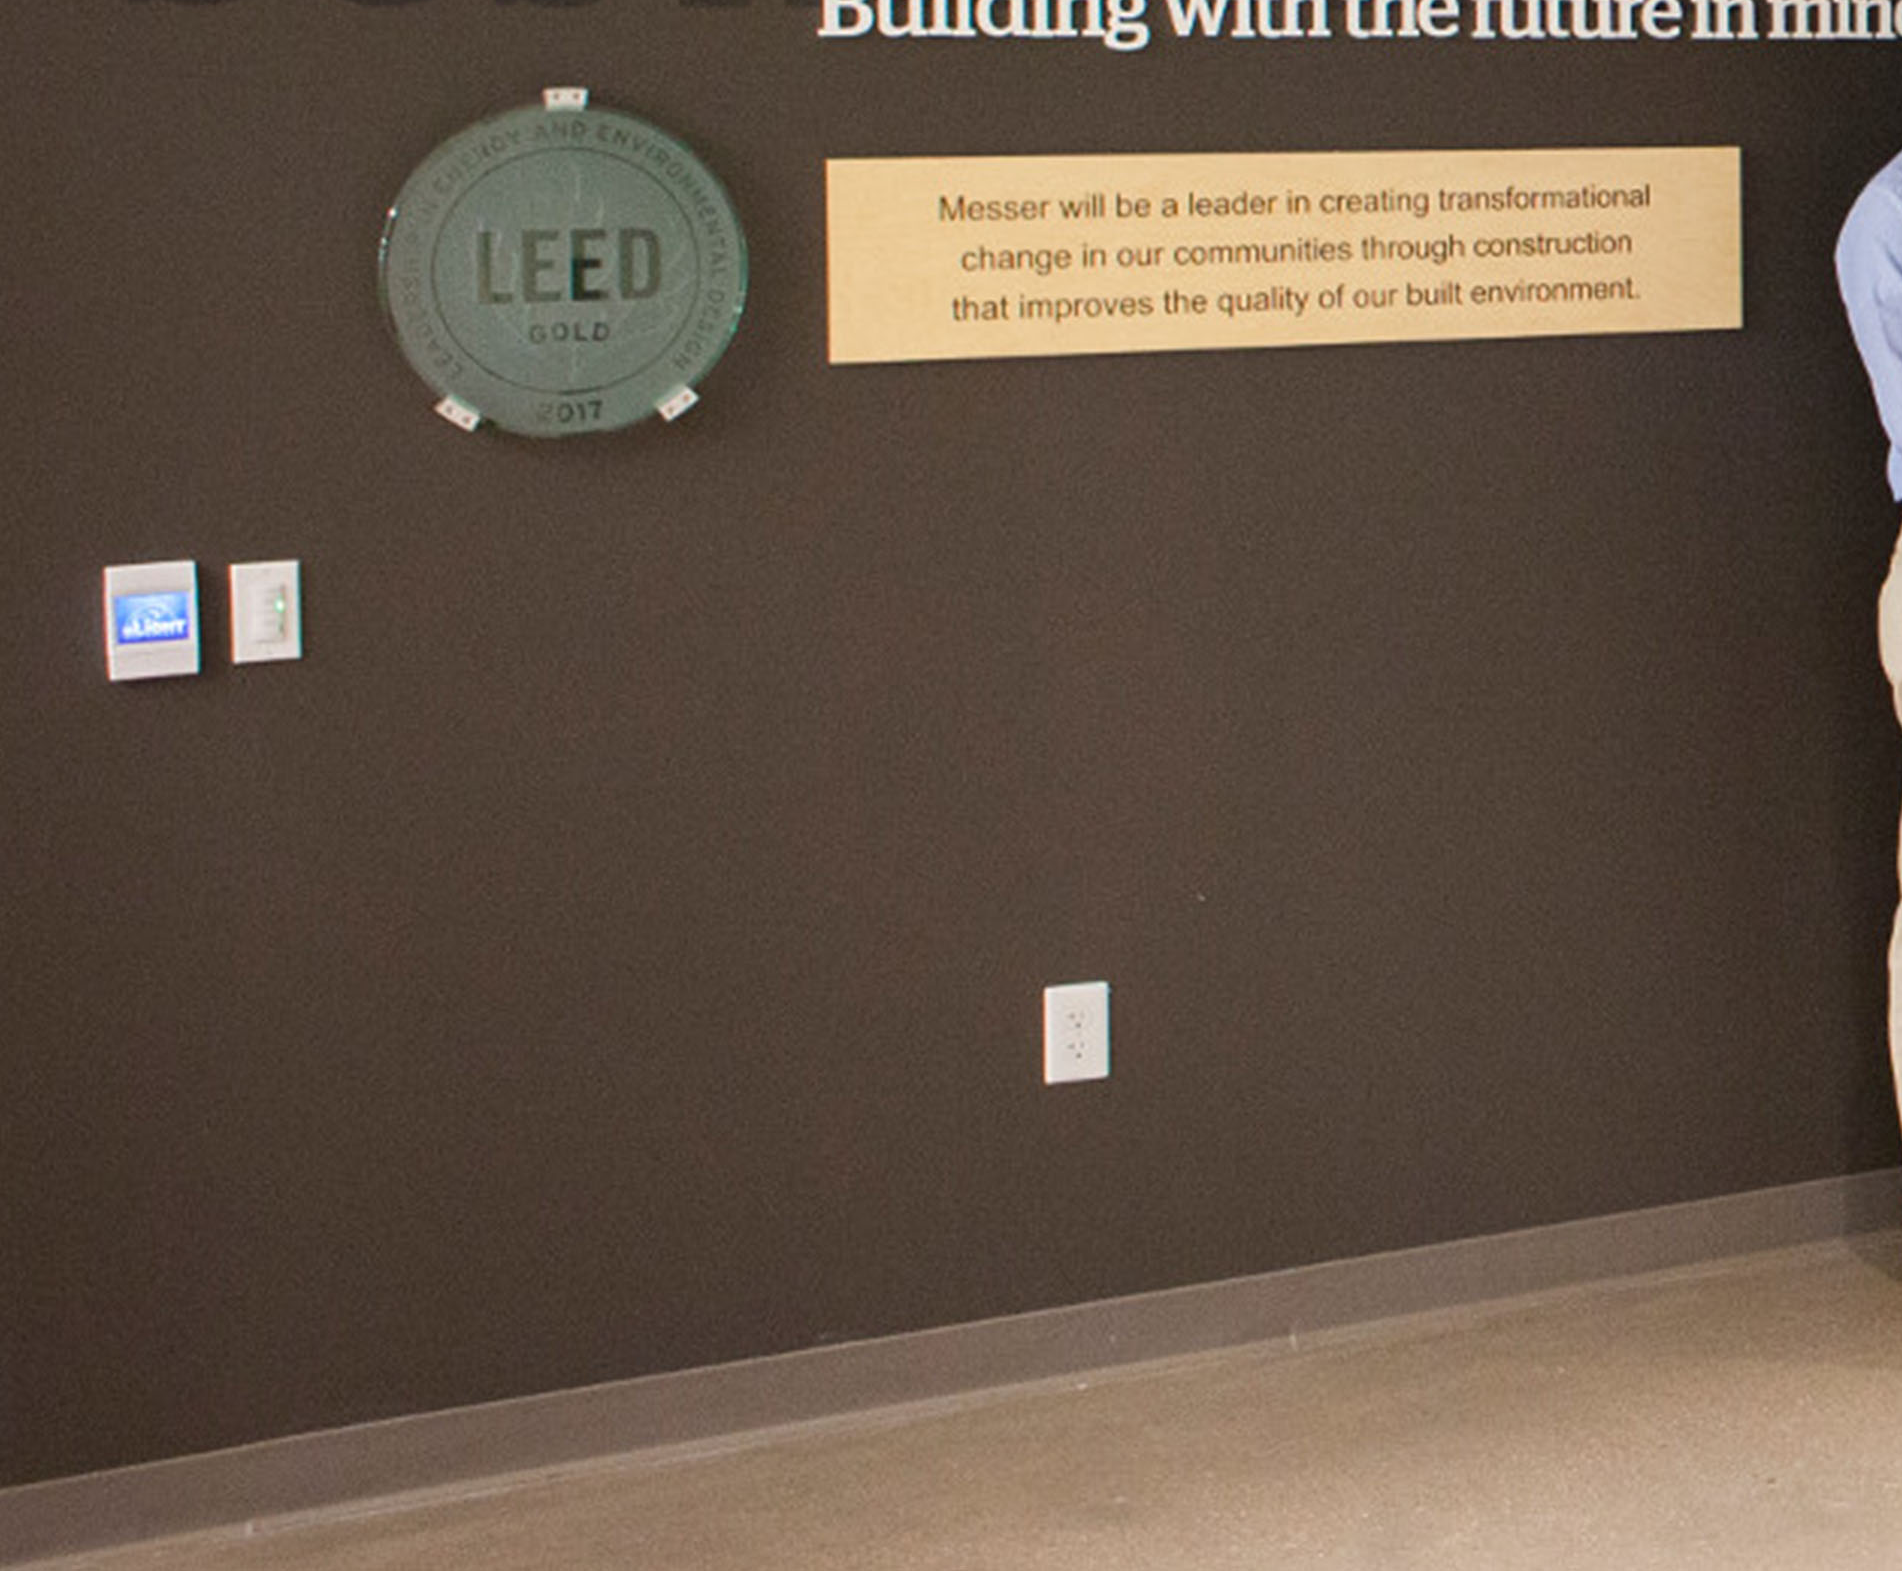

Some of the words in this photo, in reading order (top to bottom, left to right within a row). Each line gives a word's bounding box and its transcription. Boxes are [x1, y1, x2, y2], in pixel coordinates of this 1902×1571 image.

[940, 195, 1049, 221] Messer
[1060, 193, 1105, 218] will
[1116, 193, 1151, 217] be
[1162, 199, 1179, 217] a
[1189, 191, 1277, 216] leader
[1287, 191, 1310, 214] in
[1320, 188, 1430, 218] creating
[1439, 184, 1650, 212] transformational
[477, 226, 662, 304] LEED
[962, 245, 1072, 275] change
[1083, 244, 1107, 268] in
[1117, 247, 1164, 267] our
[1174, 238, 1353, 266] communities
[1362, 234, 1466, 265] through
[1473, 231, 1632, 258] construction
[953, 296, 1008, 321] that
[1020, 294, 1154, 323] improves
[1164, 290, 1208, 314] the
[1218, 285, 1309, 317] quality
[1318, 284, 1344, 309] of
[1353, 287, 1399, 309] our
[1407, 282, 1463, 306] built
[1470, 277, 1640, 304] environment.
[530, 321, 611, 345] GOLD
[539, 399, 603, 424] 2017
